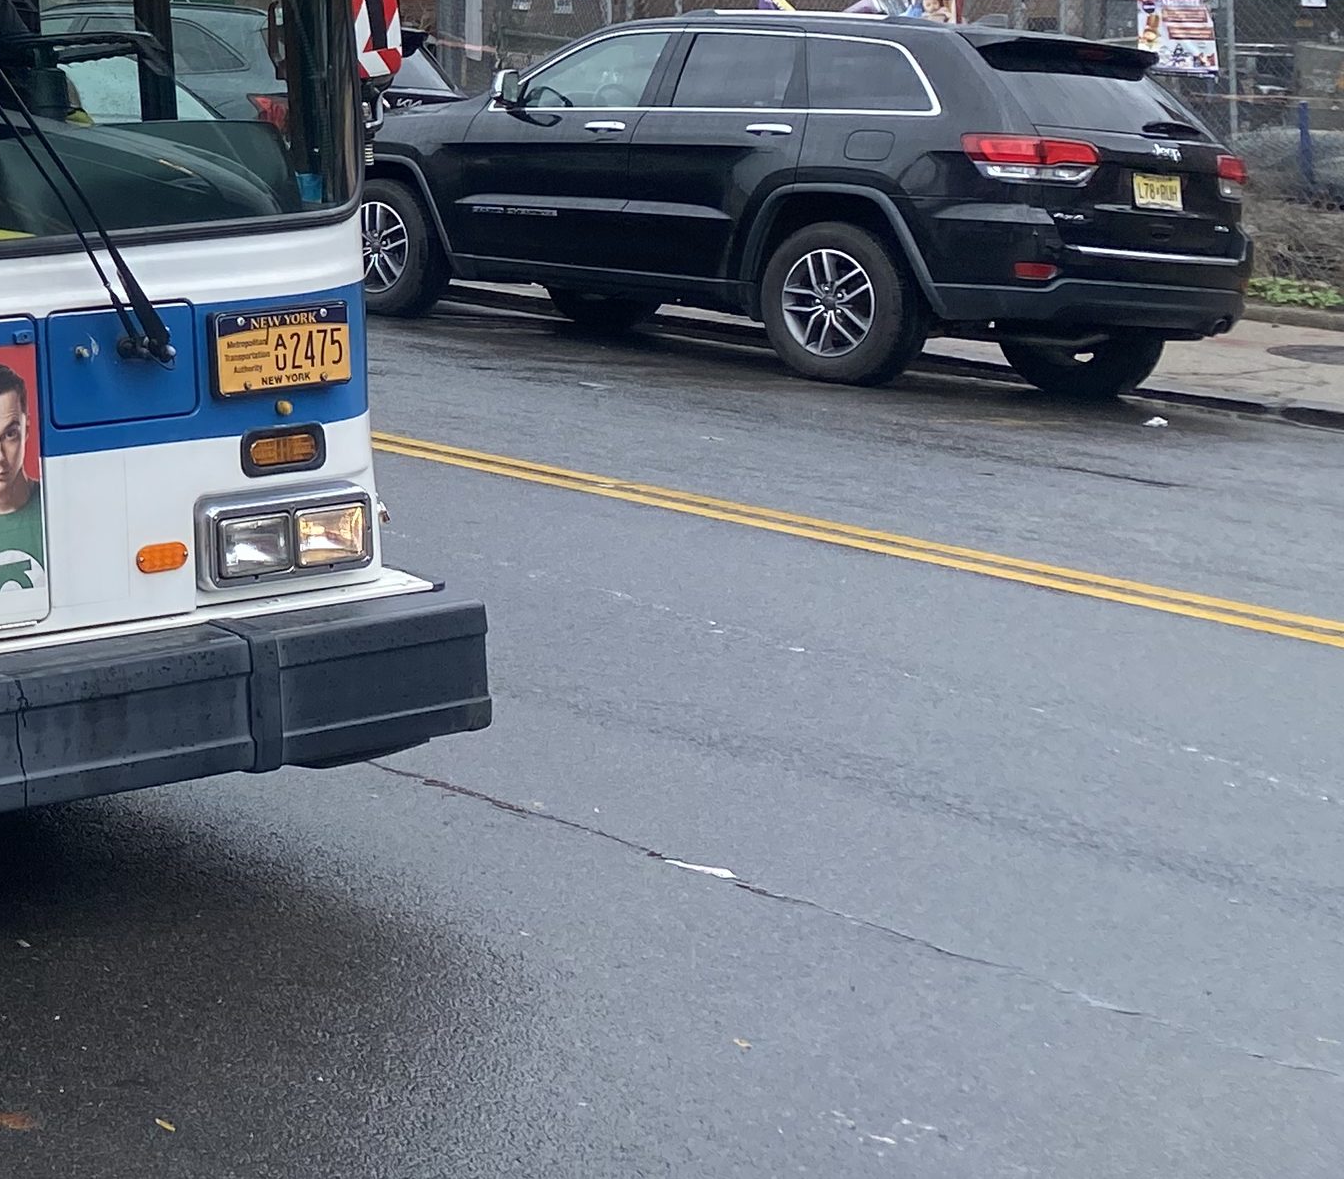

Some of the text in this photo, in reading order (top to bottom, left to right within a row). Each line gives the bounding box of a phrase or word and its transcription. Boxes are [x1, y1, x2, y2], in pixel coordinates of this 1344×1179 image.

[250, 311, 317, 330] NEW YORK
[261, 372, 312, 386] NEW YORK
